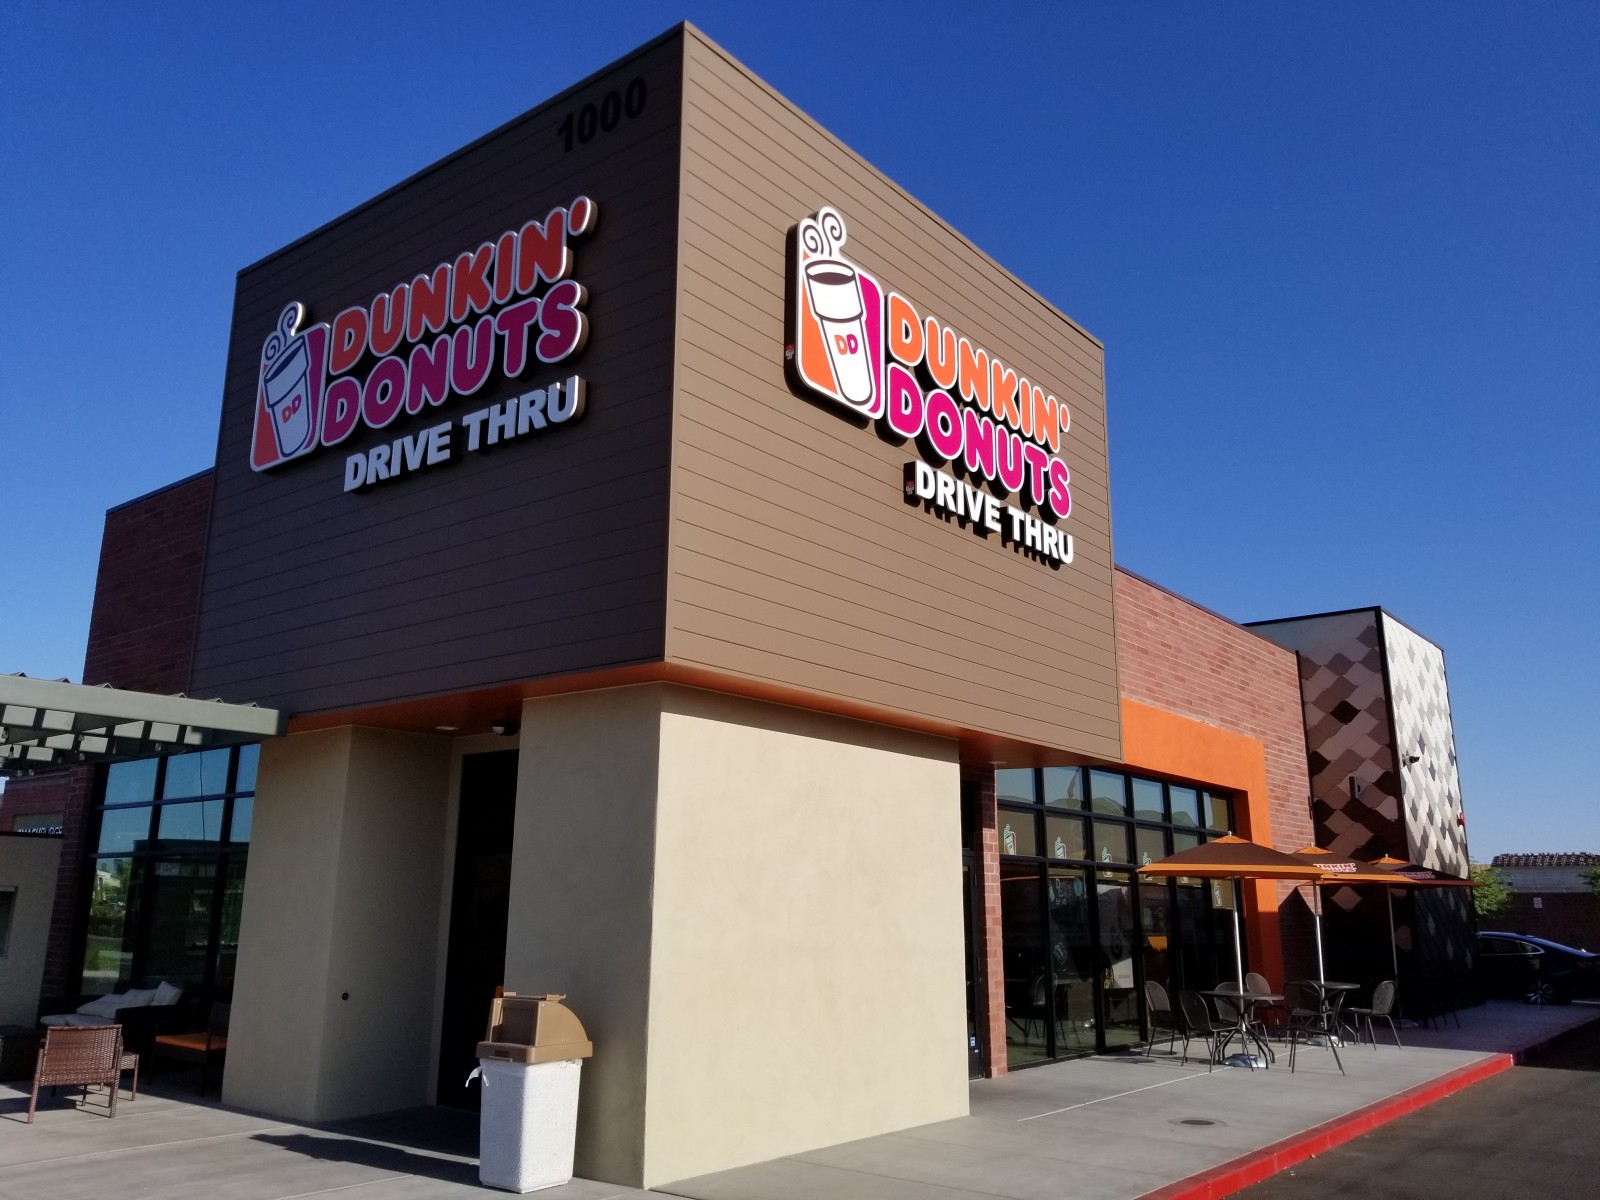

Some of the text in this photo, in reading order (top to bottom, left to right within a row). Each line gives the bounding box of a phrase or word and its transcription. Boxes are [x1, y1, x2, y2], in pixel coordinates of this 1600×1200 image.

[558, 78, 647, 152] 1000
[330, 195, 597, 374] DUNKIN'
[322, 280, 588, 446] DONUTS
[834, 334, 859, 355] DD
[887, 292, 1070, 453] DUNKIN'
[281, 393, 302, 424] DD
[344, 375, 584, 492] DRIVE THRU
[887, 363, 1072, 518] DONUTS
[916, 460, 1074, 564] DRIVE THRU
